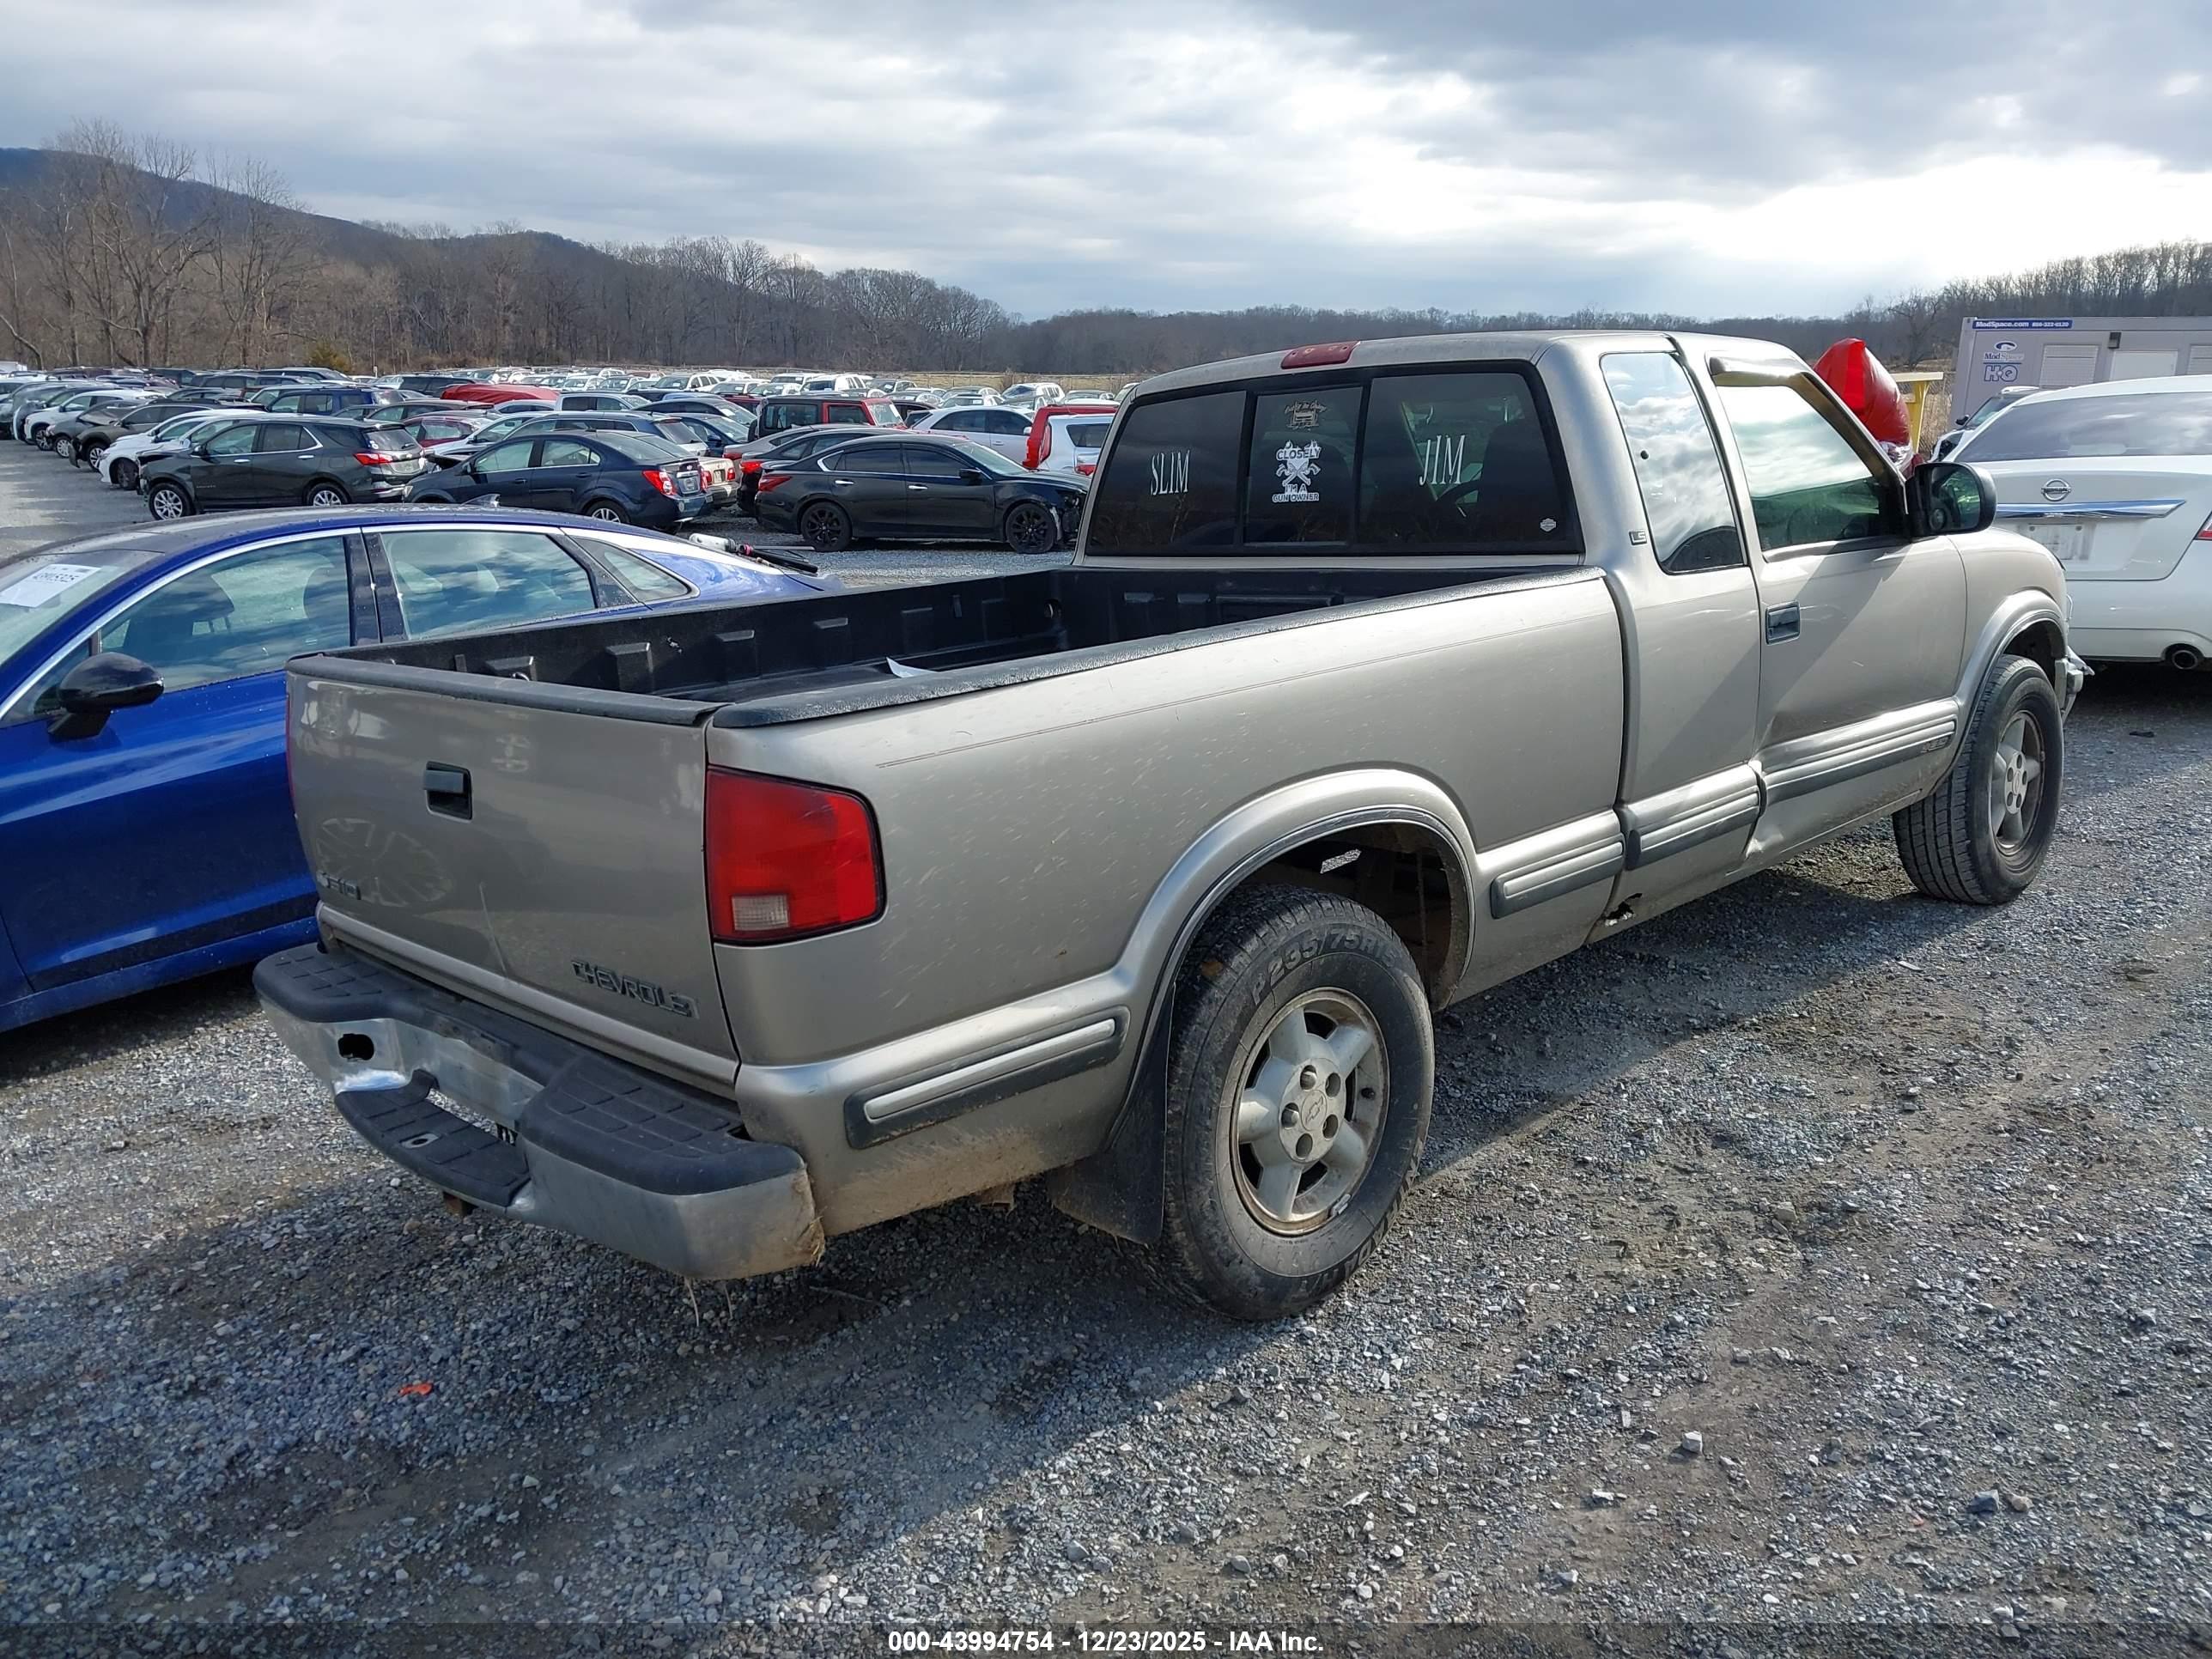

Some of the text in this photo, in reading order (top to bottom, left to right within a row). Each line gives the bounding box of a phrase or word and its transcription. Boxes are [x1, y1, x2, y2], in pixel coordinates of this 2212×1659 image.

[1276, 447, 1321, 460] CLOSELY
[1419, 434, 1466, 486] JIM
[1151, 450, 1190, 495] SLIM
[1299, 483, 1307, 494] A
[1273, 493, 1319, 502] GUN OWNER
